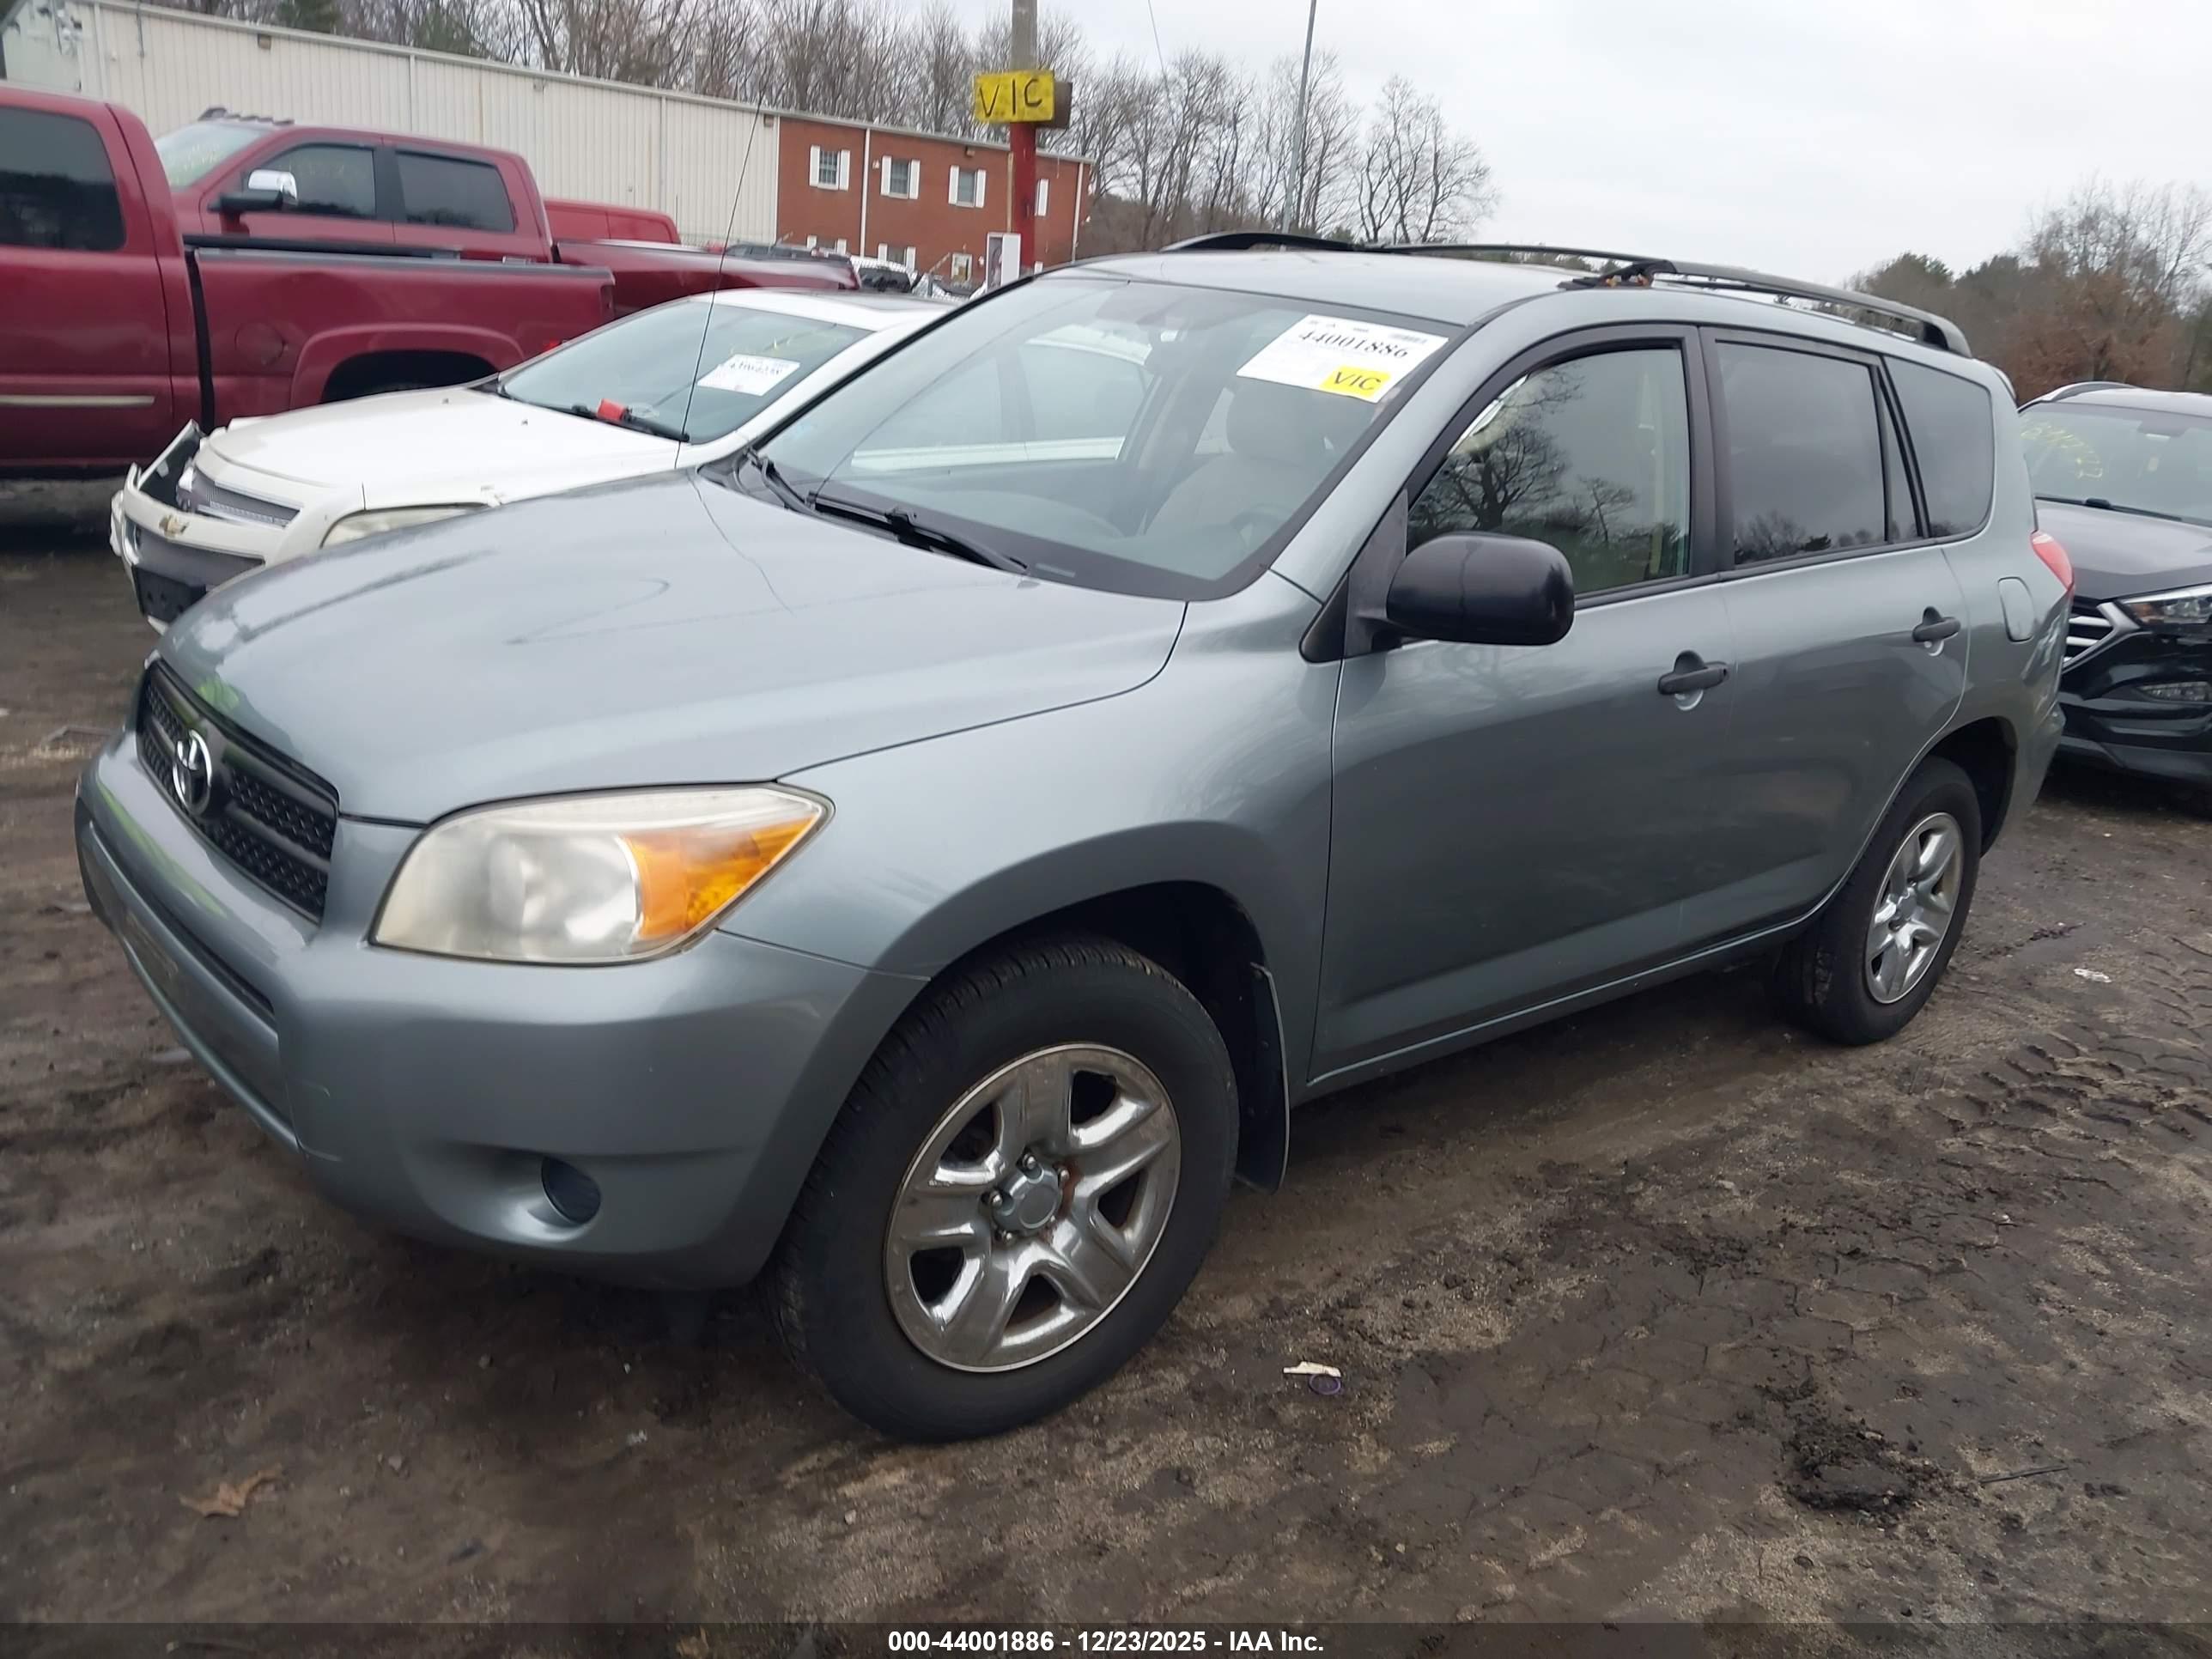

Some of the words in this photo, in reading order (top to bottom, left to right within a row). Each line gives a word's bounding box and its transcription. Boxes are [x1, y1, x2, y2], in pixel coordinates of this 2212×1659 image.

[979, 78, 1042, 117] VIC
[1298, 331, 1408, 358] 44001886
[1334, 371, 1382, 392] VIC
